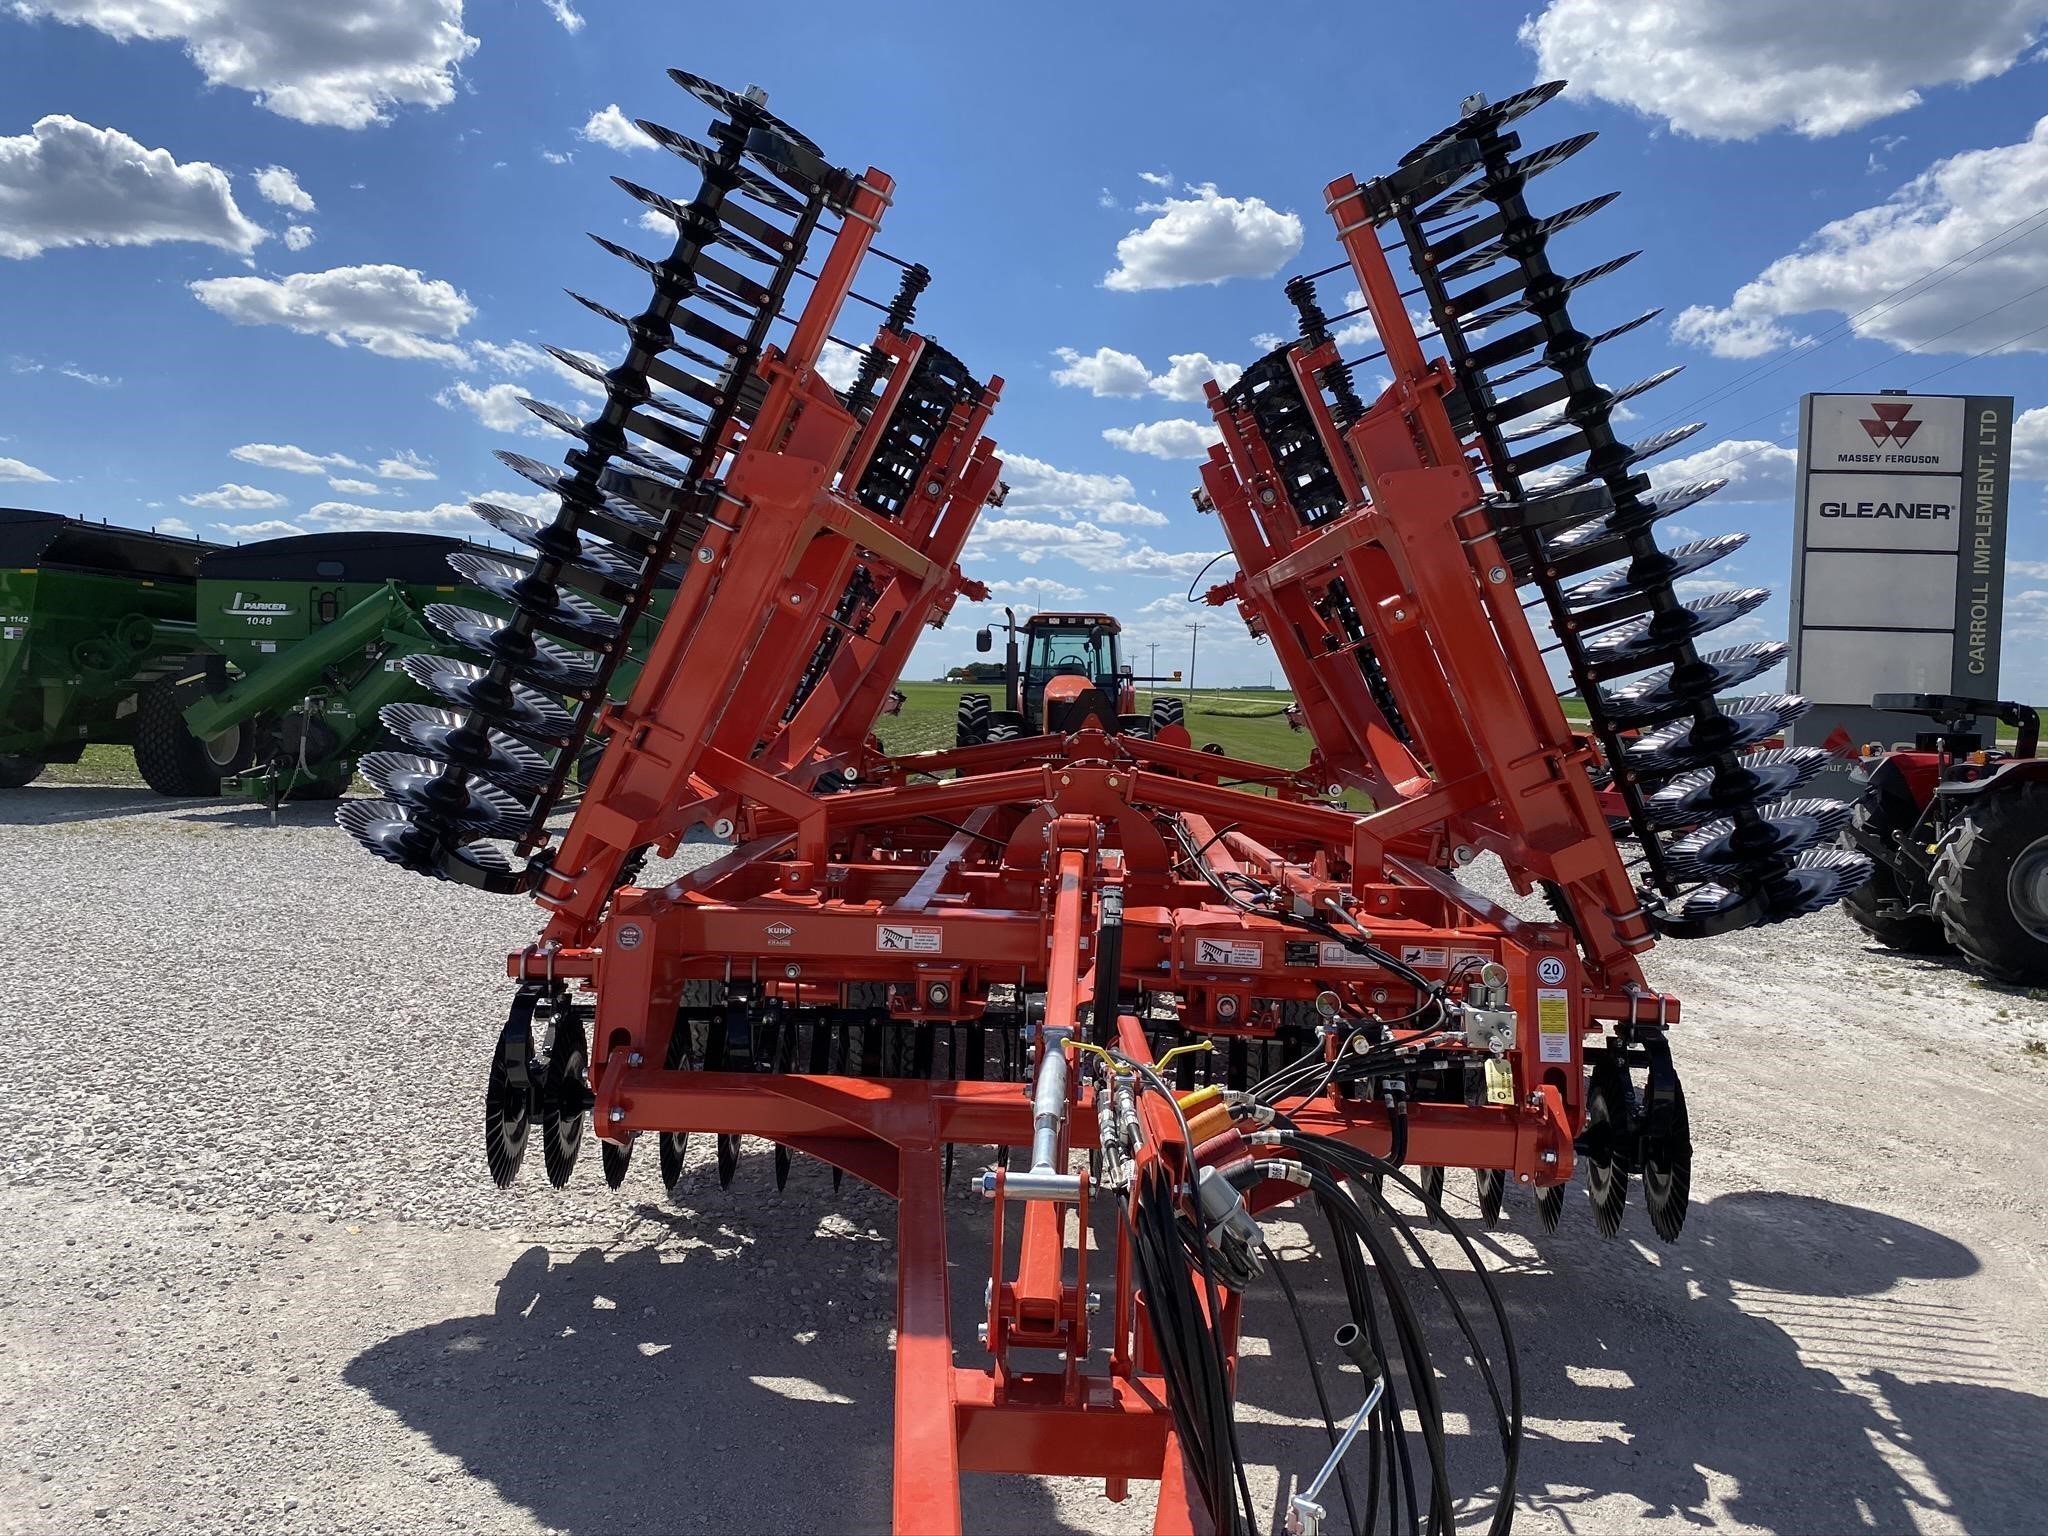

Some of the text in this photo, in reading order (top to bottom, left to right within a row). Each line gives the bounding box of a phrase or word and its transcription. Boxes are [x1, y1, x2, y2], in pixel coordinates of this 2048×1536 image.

[1838, 454, 1940, 465] MASSEY FERGUSON
[1819, 502, 1951, 520] GLEANER
[1968, 410, 1998, 674] CARROLL IMPLEMENT, LTD
[243, 602, 287, 611] PARKER
[246, 617, 272, 625] 1048
[1543, 963, 1560, 975] 20
